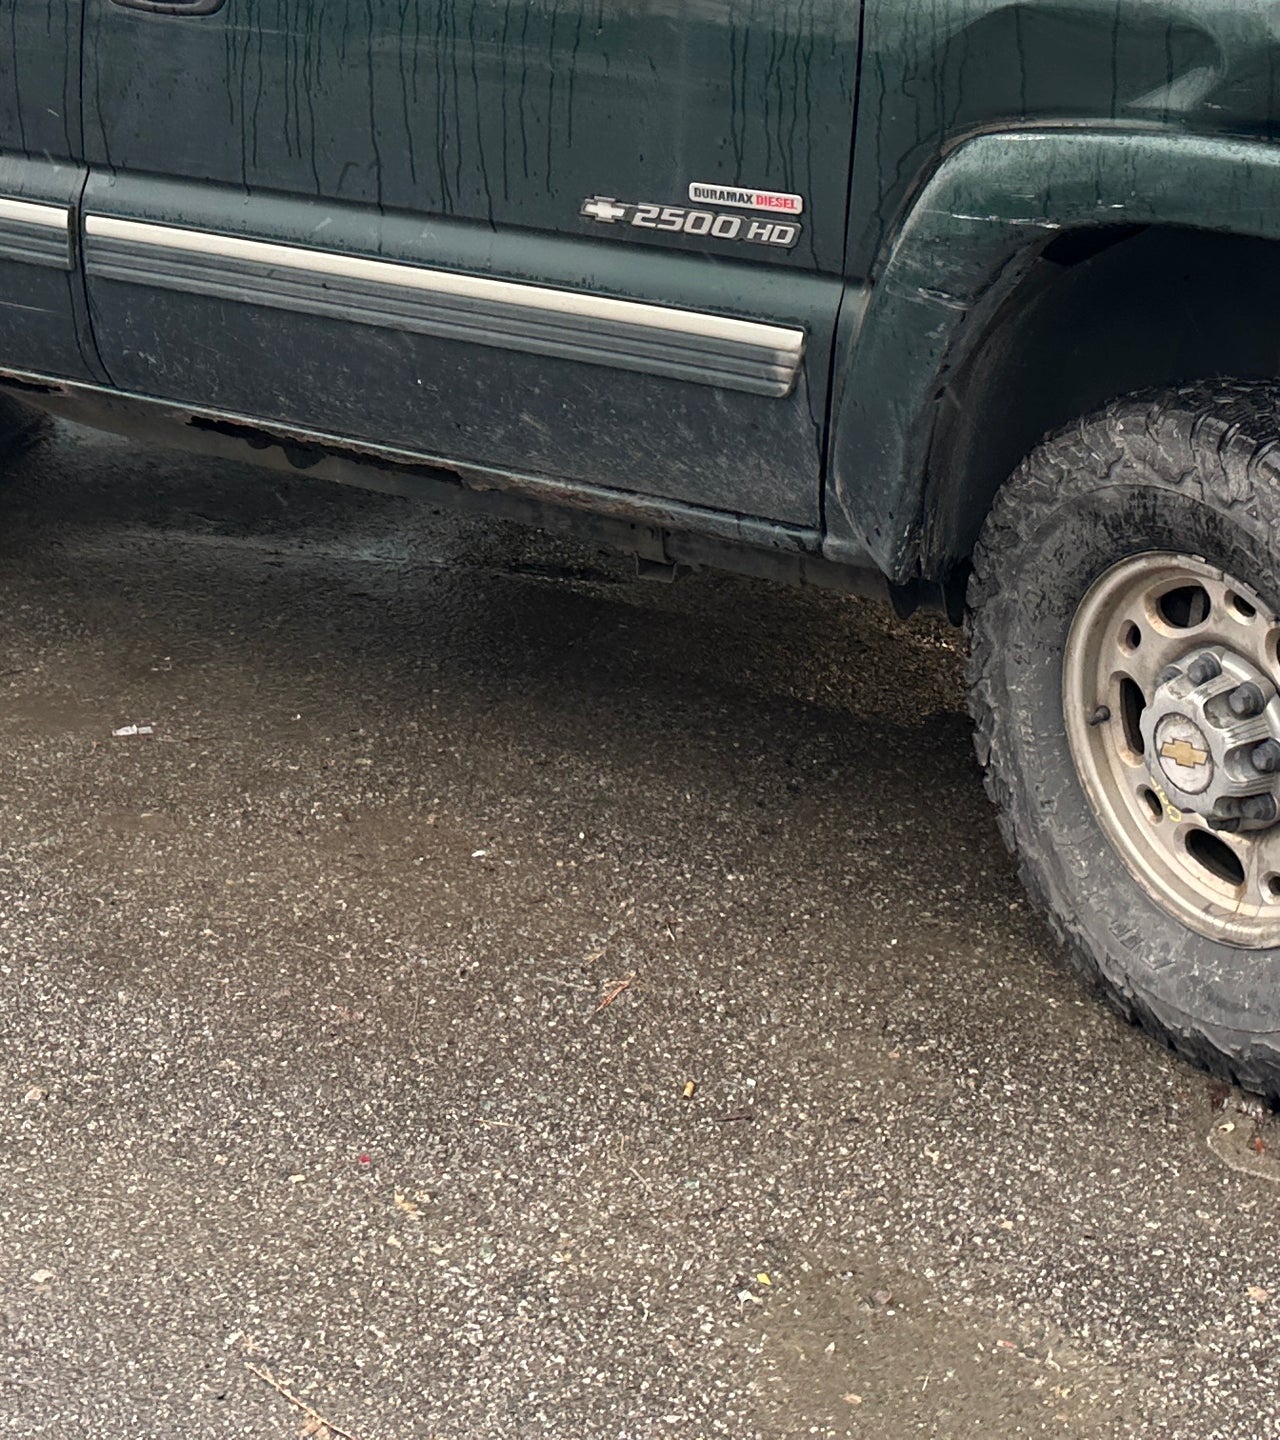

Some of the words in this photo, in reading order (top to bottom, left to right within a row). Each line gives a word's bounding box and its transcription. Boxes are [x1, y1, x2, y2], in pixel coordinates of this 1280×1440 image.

[693, 186, 753, 205] DURAMAX
[754, 195, 798, 210] DIESEL
[631, 205, 742, 239] 2500
[746, 222, 797, 245] HD
